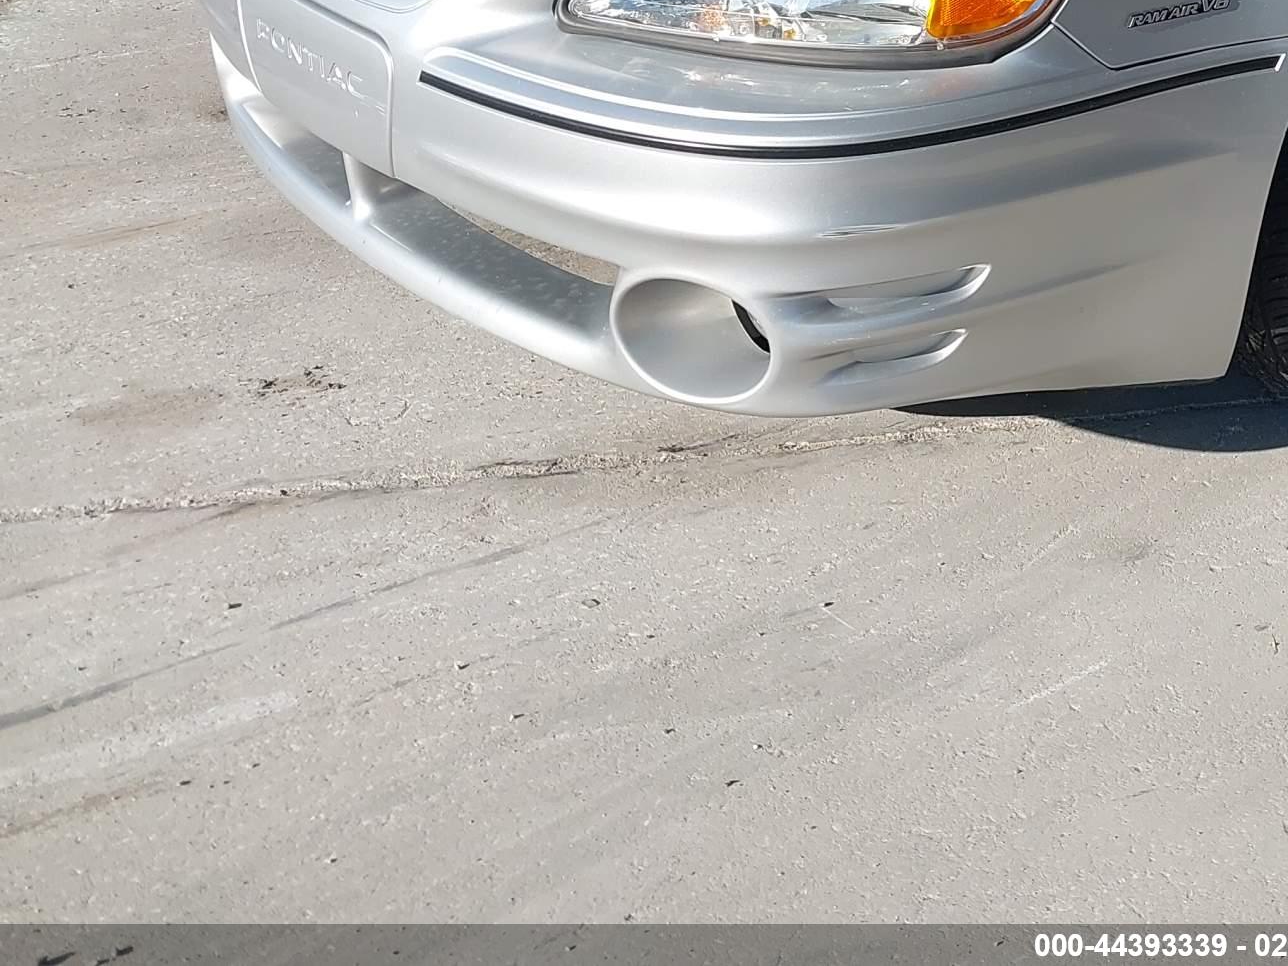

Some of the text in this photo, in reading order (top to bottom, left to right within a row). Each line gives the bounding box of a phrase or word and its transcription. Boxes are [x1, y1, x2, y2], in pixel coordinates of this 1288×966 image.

[1128, 10, 1168, 28] RAM
[1167, 3, 1200, 20] AIR
[256, 18, 367, 99] PONTIAC
